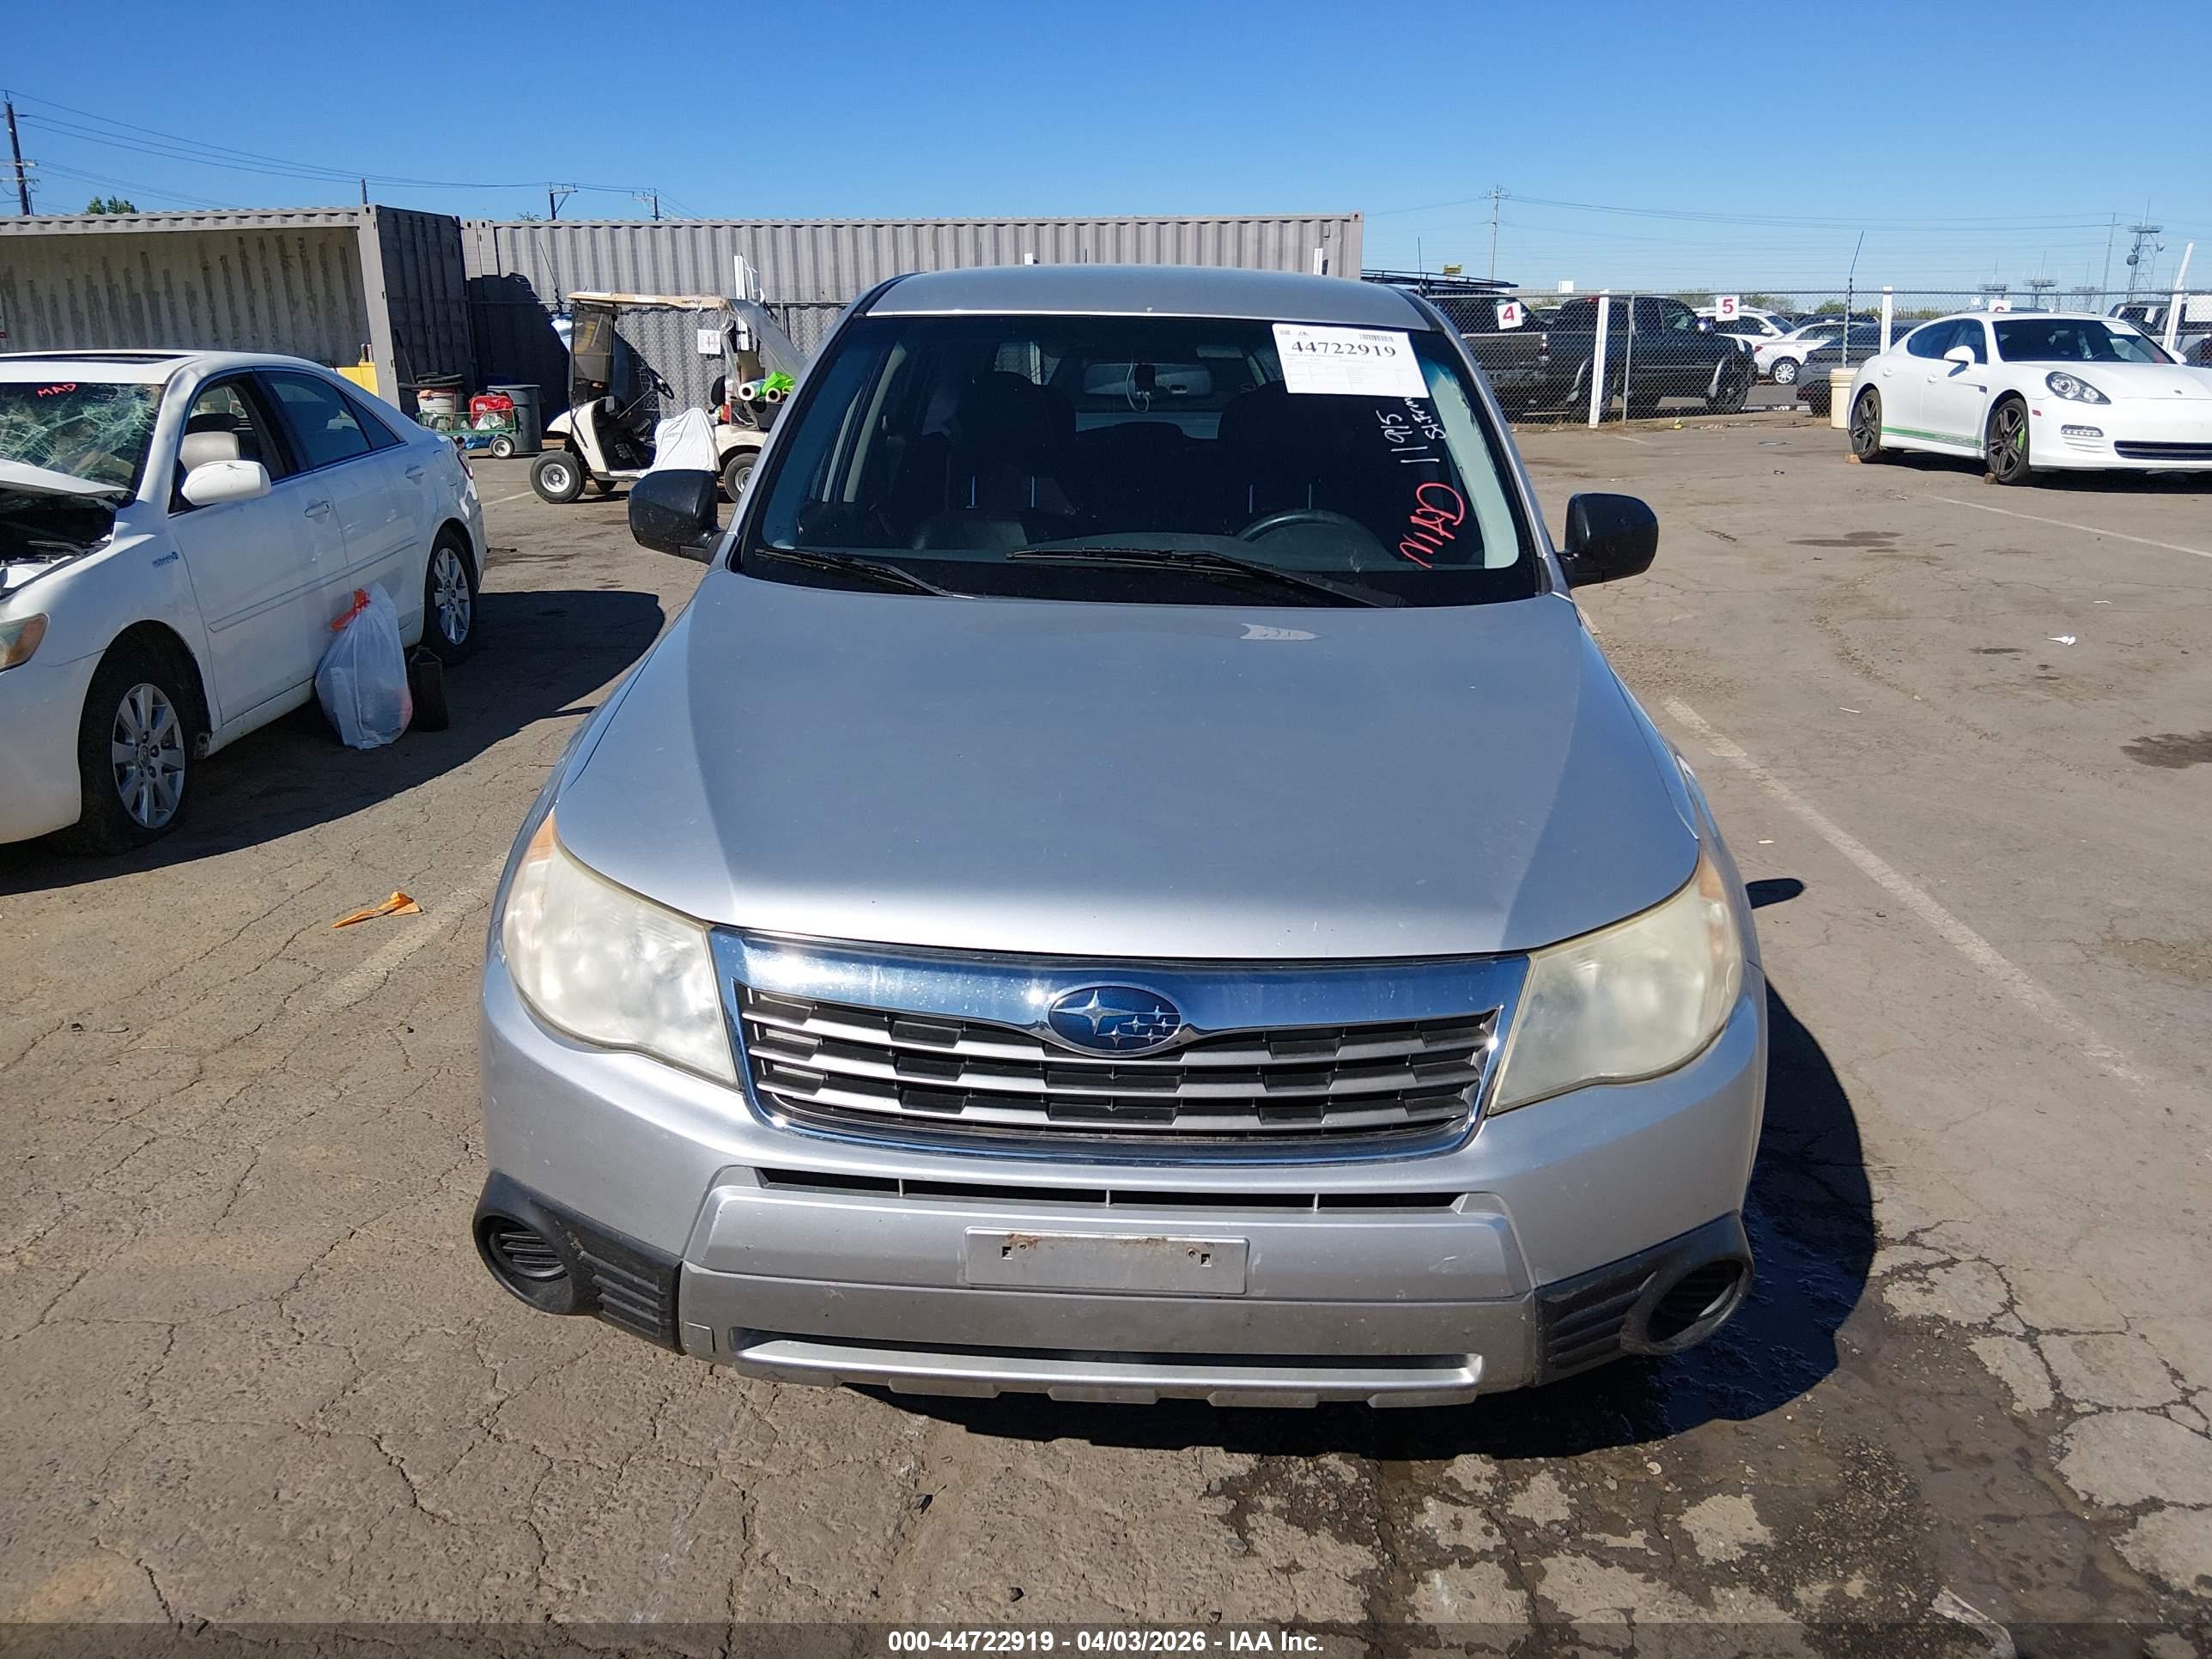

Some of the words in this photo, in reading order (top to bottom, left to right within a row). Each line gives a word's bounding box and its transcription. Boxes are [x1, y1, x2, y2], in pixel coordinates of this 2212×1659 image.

[1502, 306, 1516, 323] 4
[1722, 297, 1735, 315] 5
[1291, 340, 1397, 358] 44722919
[37, 382, 76, 398] MAD
